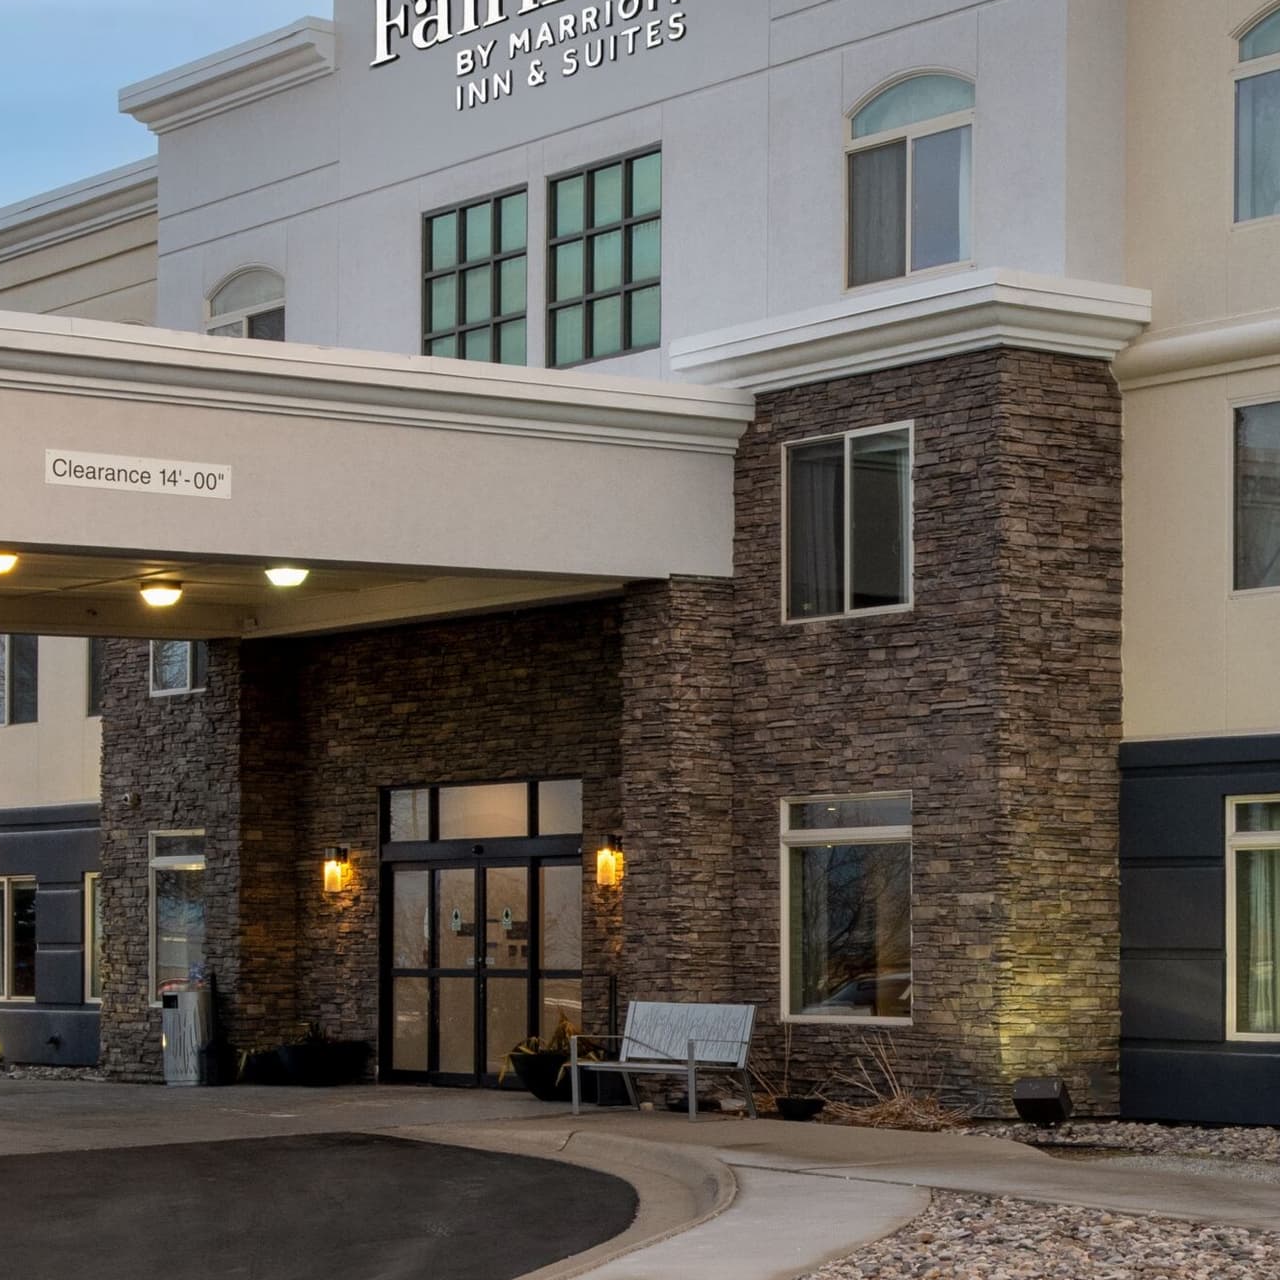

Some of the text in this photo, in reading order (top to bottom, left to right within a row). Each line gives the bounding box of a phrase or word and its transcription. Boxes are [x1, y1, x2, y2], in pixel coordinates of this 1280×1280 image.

[455, 12, 687, 111] INN & SUITES
[456, 39, 497, 76] BY
[52, 458, 151, 484] Clearance
